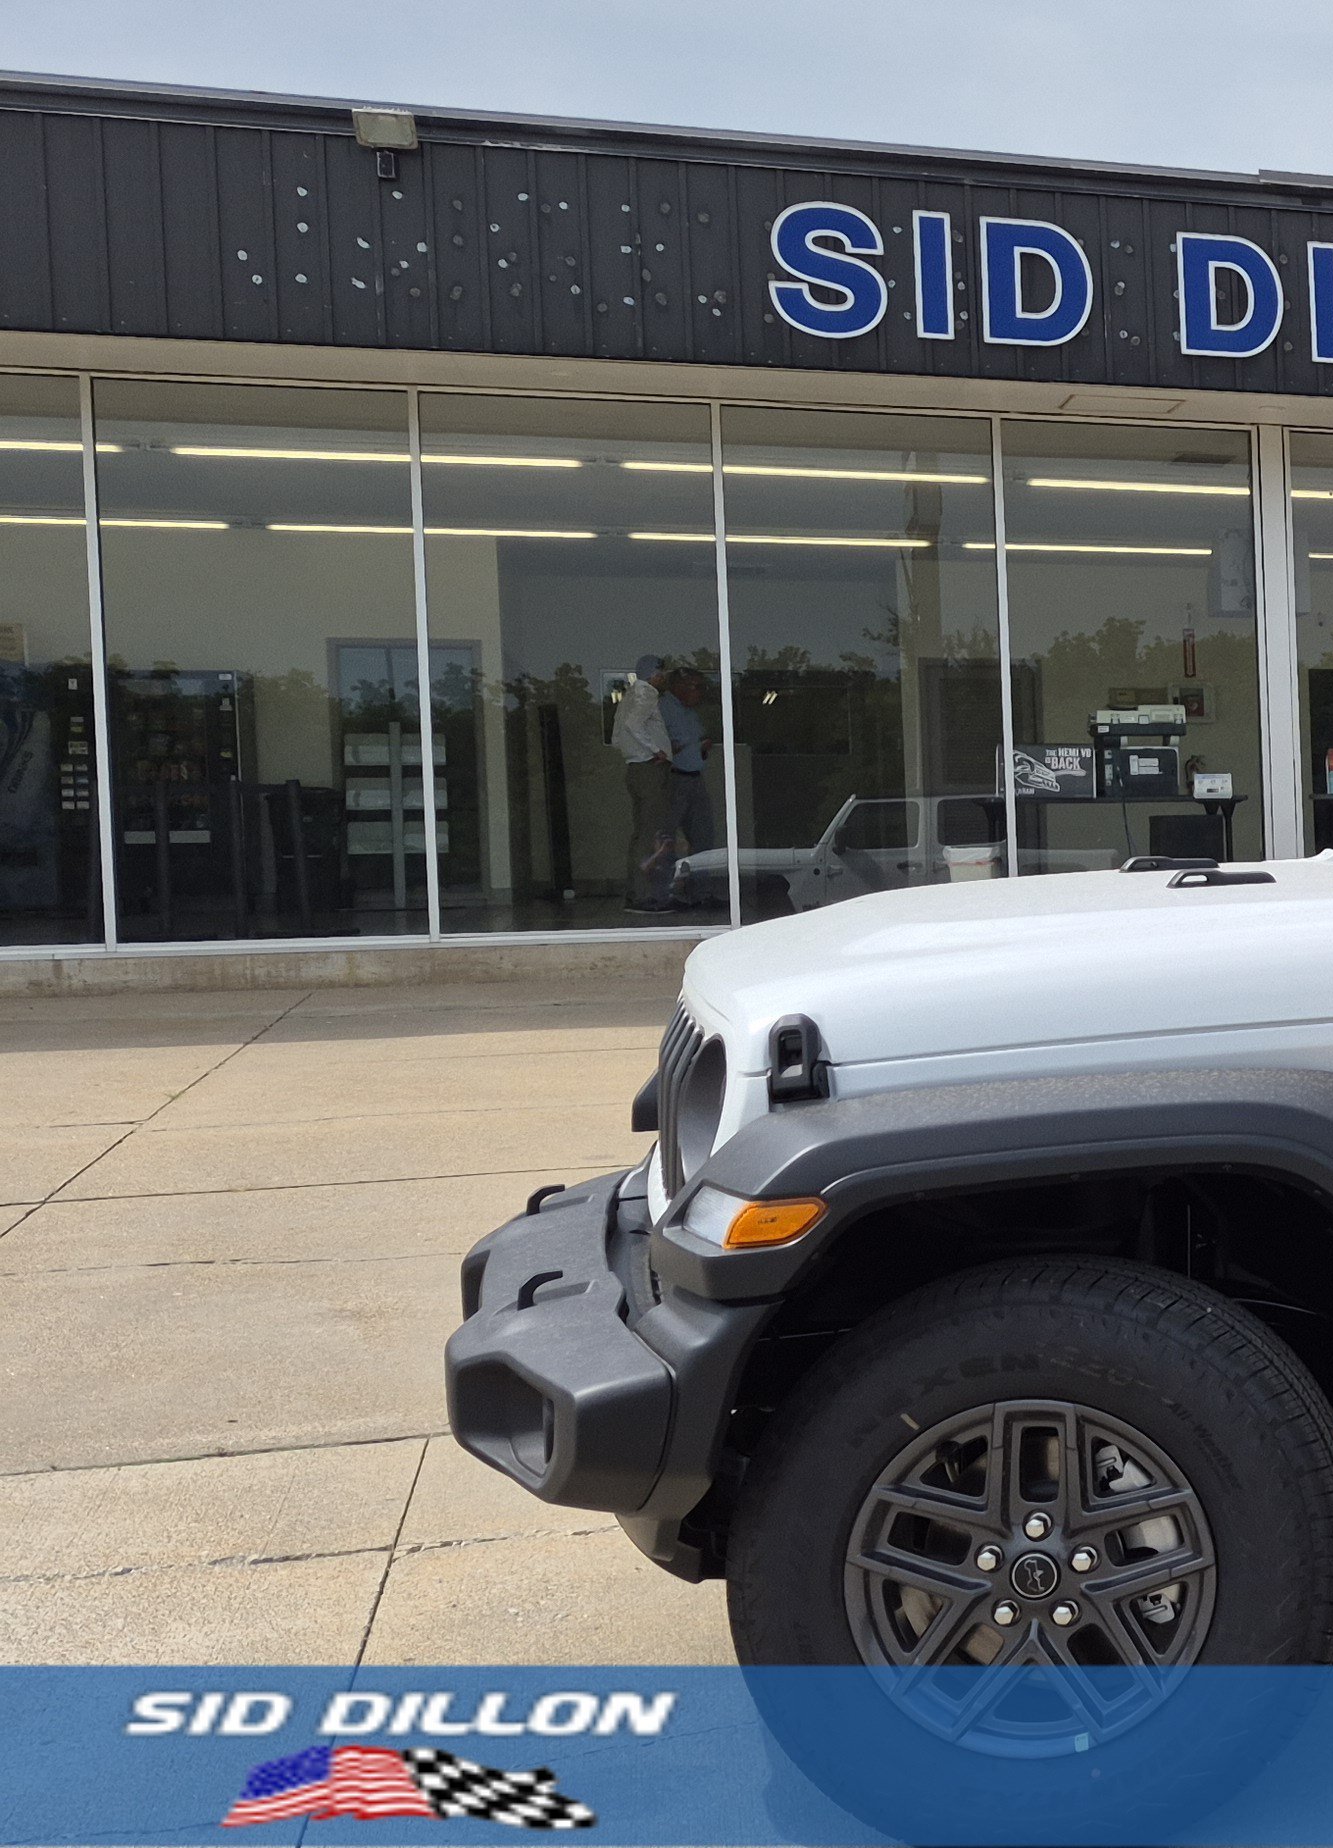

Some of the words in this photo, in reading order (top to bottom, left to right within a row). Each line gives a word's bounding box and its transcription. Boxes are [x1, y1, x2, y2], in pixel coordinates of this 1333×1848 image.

[768, 201, 1094, 347] SID
[1058, 747, 1080, 757] HEMI
[1051, 757, 1082, 770] BACK
